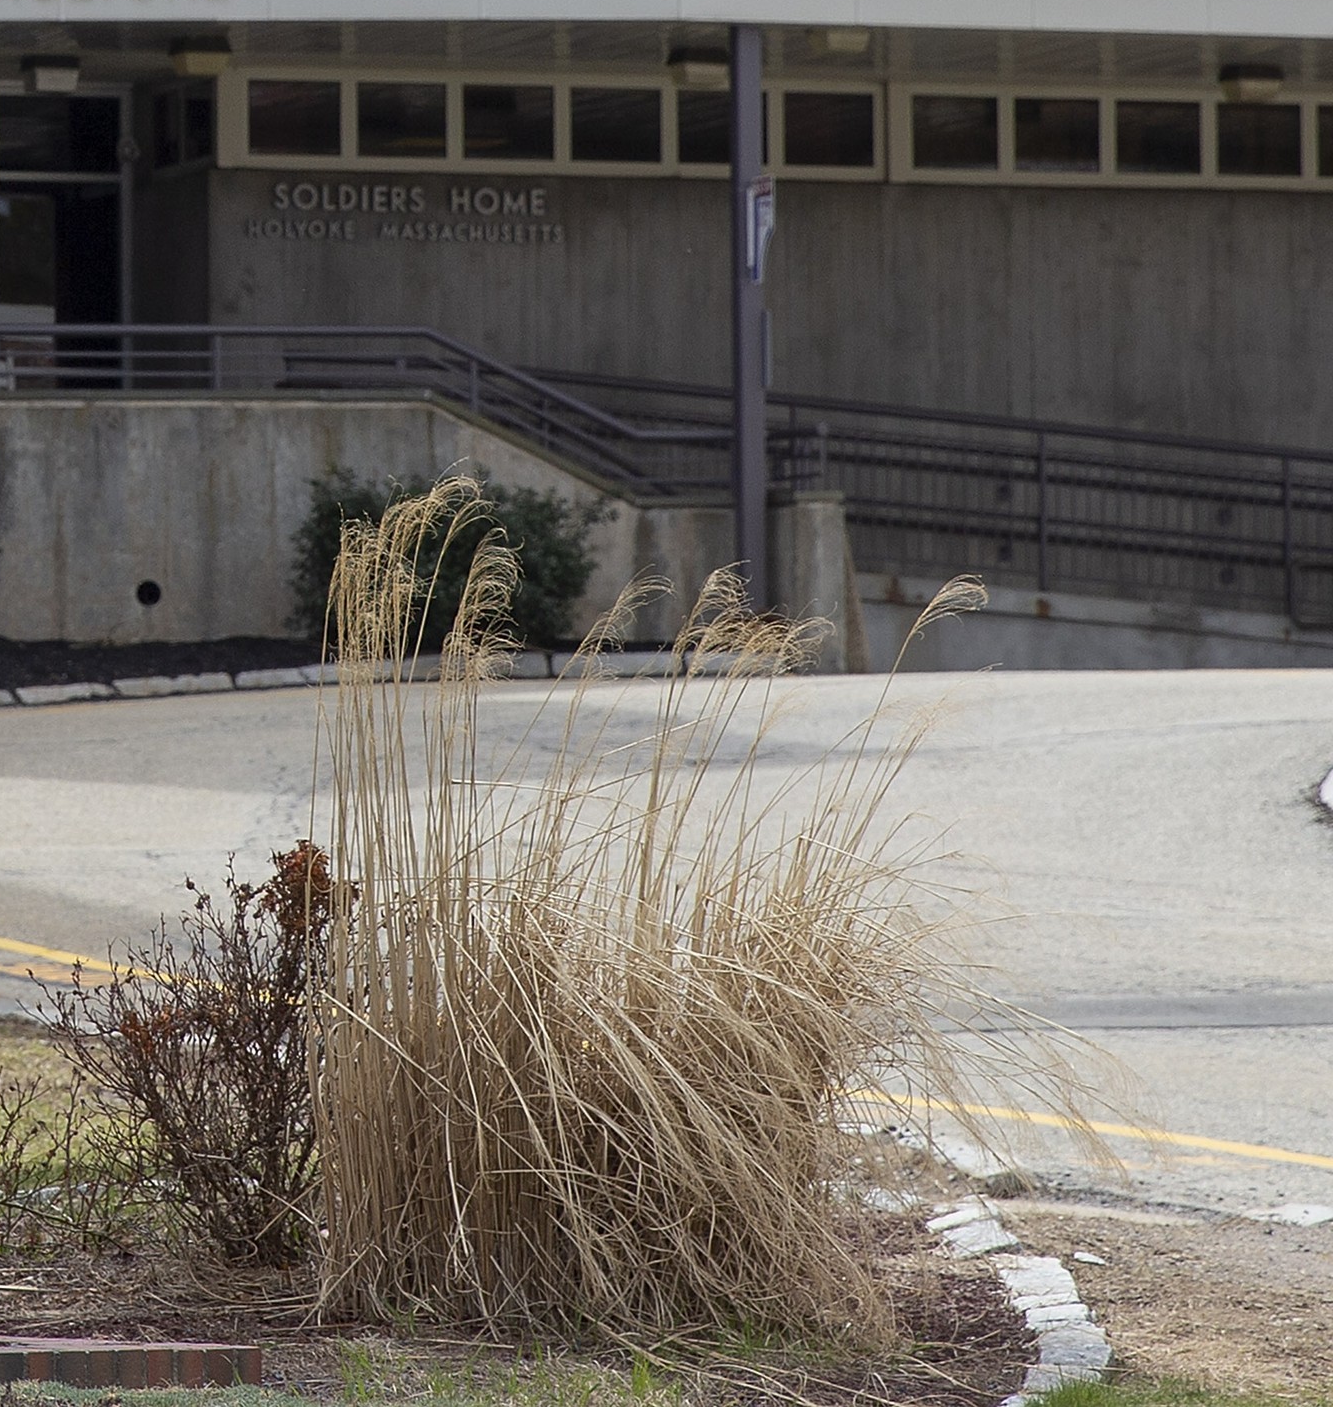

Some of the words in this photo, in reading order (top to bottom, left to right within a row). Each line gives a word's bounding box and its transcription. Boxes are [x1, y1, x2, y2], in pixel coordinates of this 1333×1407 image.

[273, 182, 425, 213] SOLDIERS
[449, 186, 547, 215] HOME
[245, 218, 357, 241] HOLYOKE
[379, 220, 566, 244] MASSACHUSETTS
